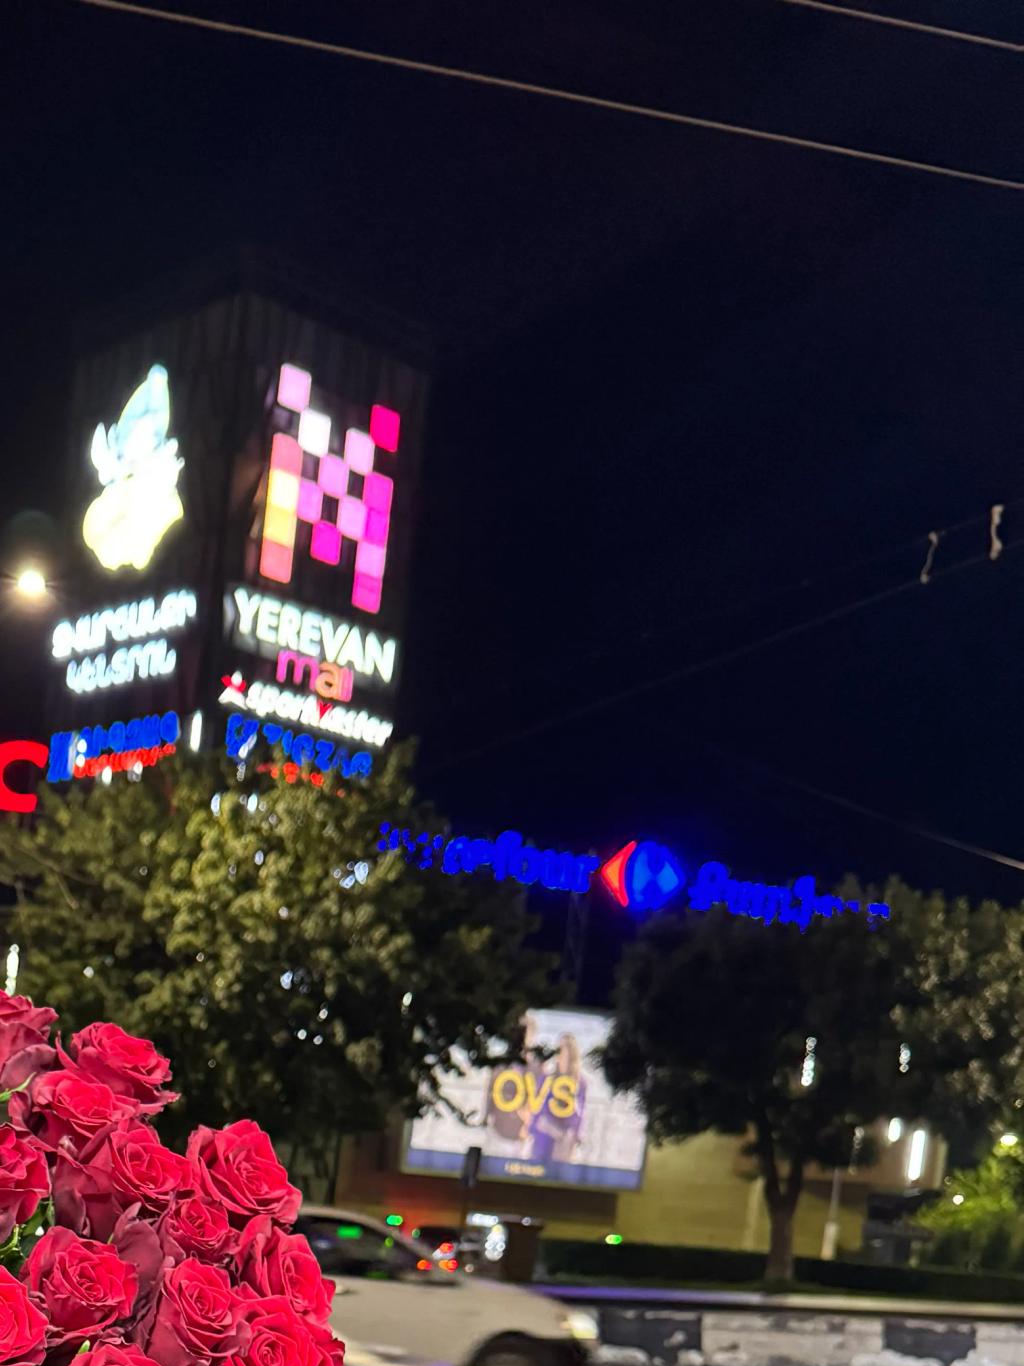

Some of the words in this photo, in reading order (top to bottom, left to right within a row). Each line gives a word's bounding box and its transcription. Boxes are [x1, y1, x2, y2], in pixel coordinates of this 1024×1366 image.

[234, 587, 396, 684] YEREVAN
[276, 650, 354, 702] mall
[492, 1069, 577, 1118] OVS
